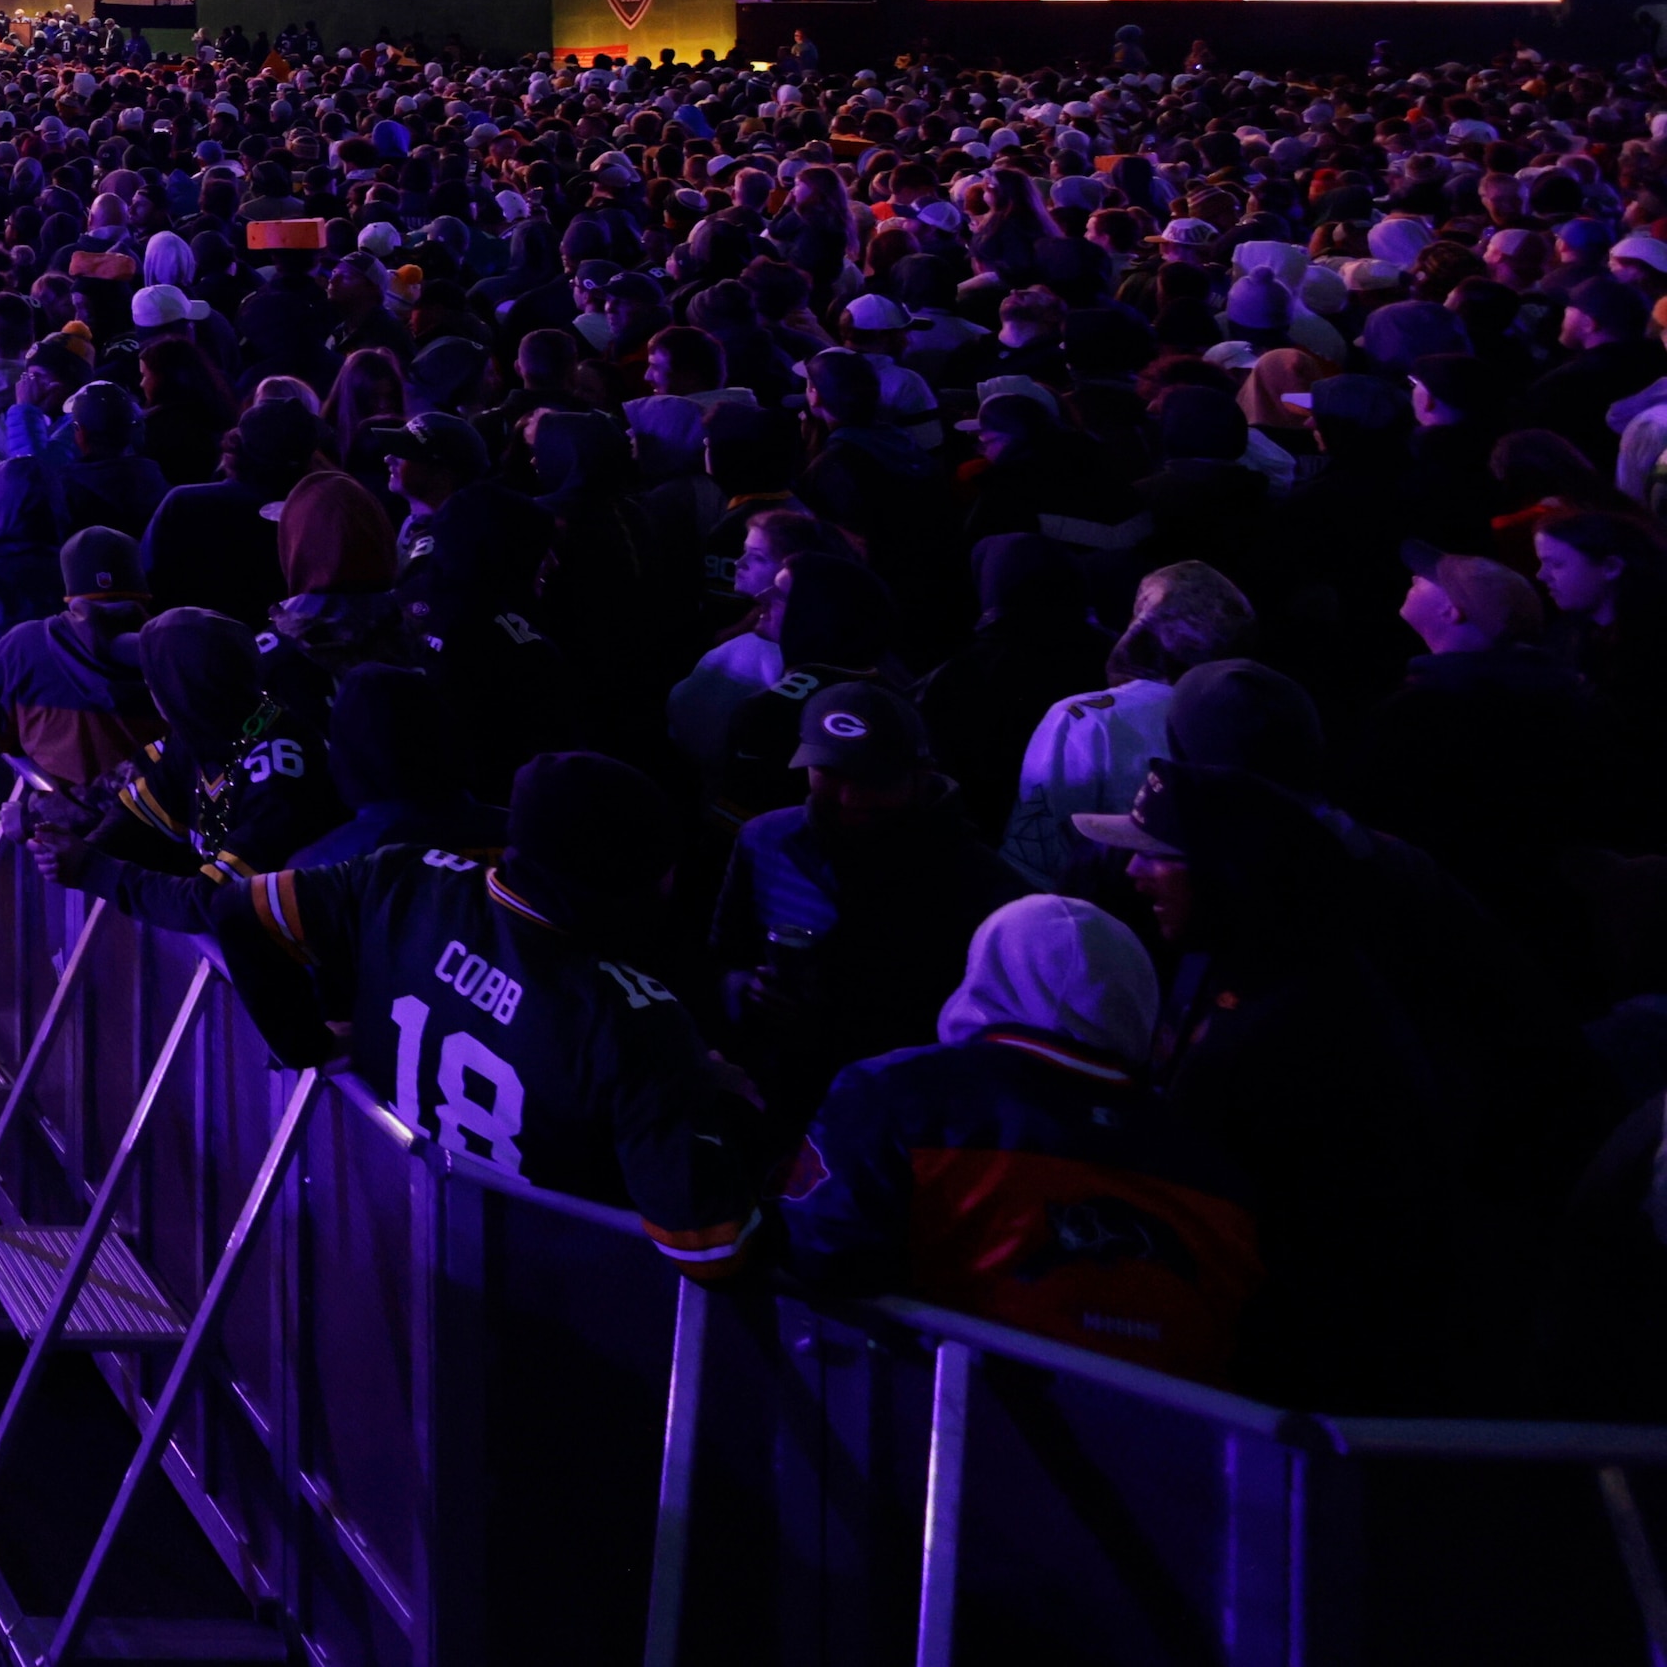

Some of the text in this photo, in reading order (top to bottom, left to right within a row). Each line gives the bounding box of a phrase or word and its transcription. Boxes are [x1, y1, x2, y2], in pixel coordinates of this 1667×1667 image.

[244, 738, 305, 783] 56
[434, 939, 523, 1026] COBB
[390, 994, 531, 1186] 18
